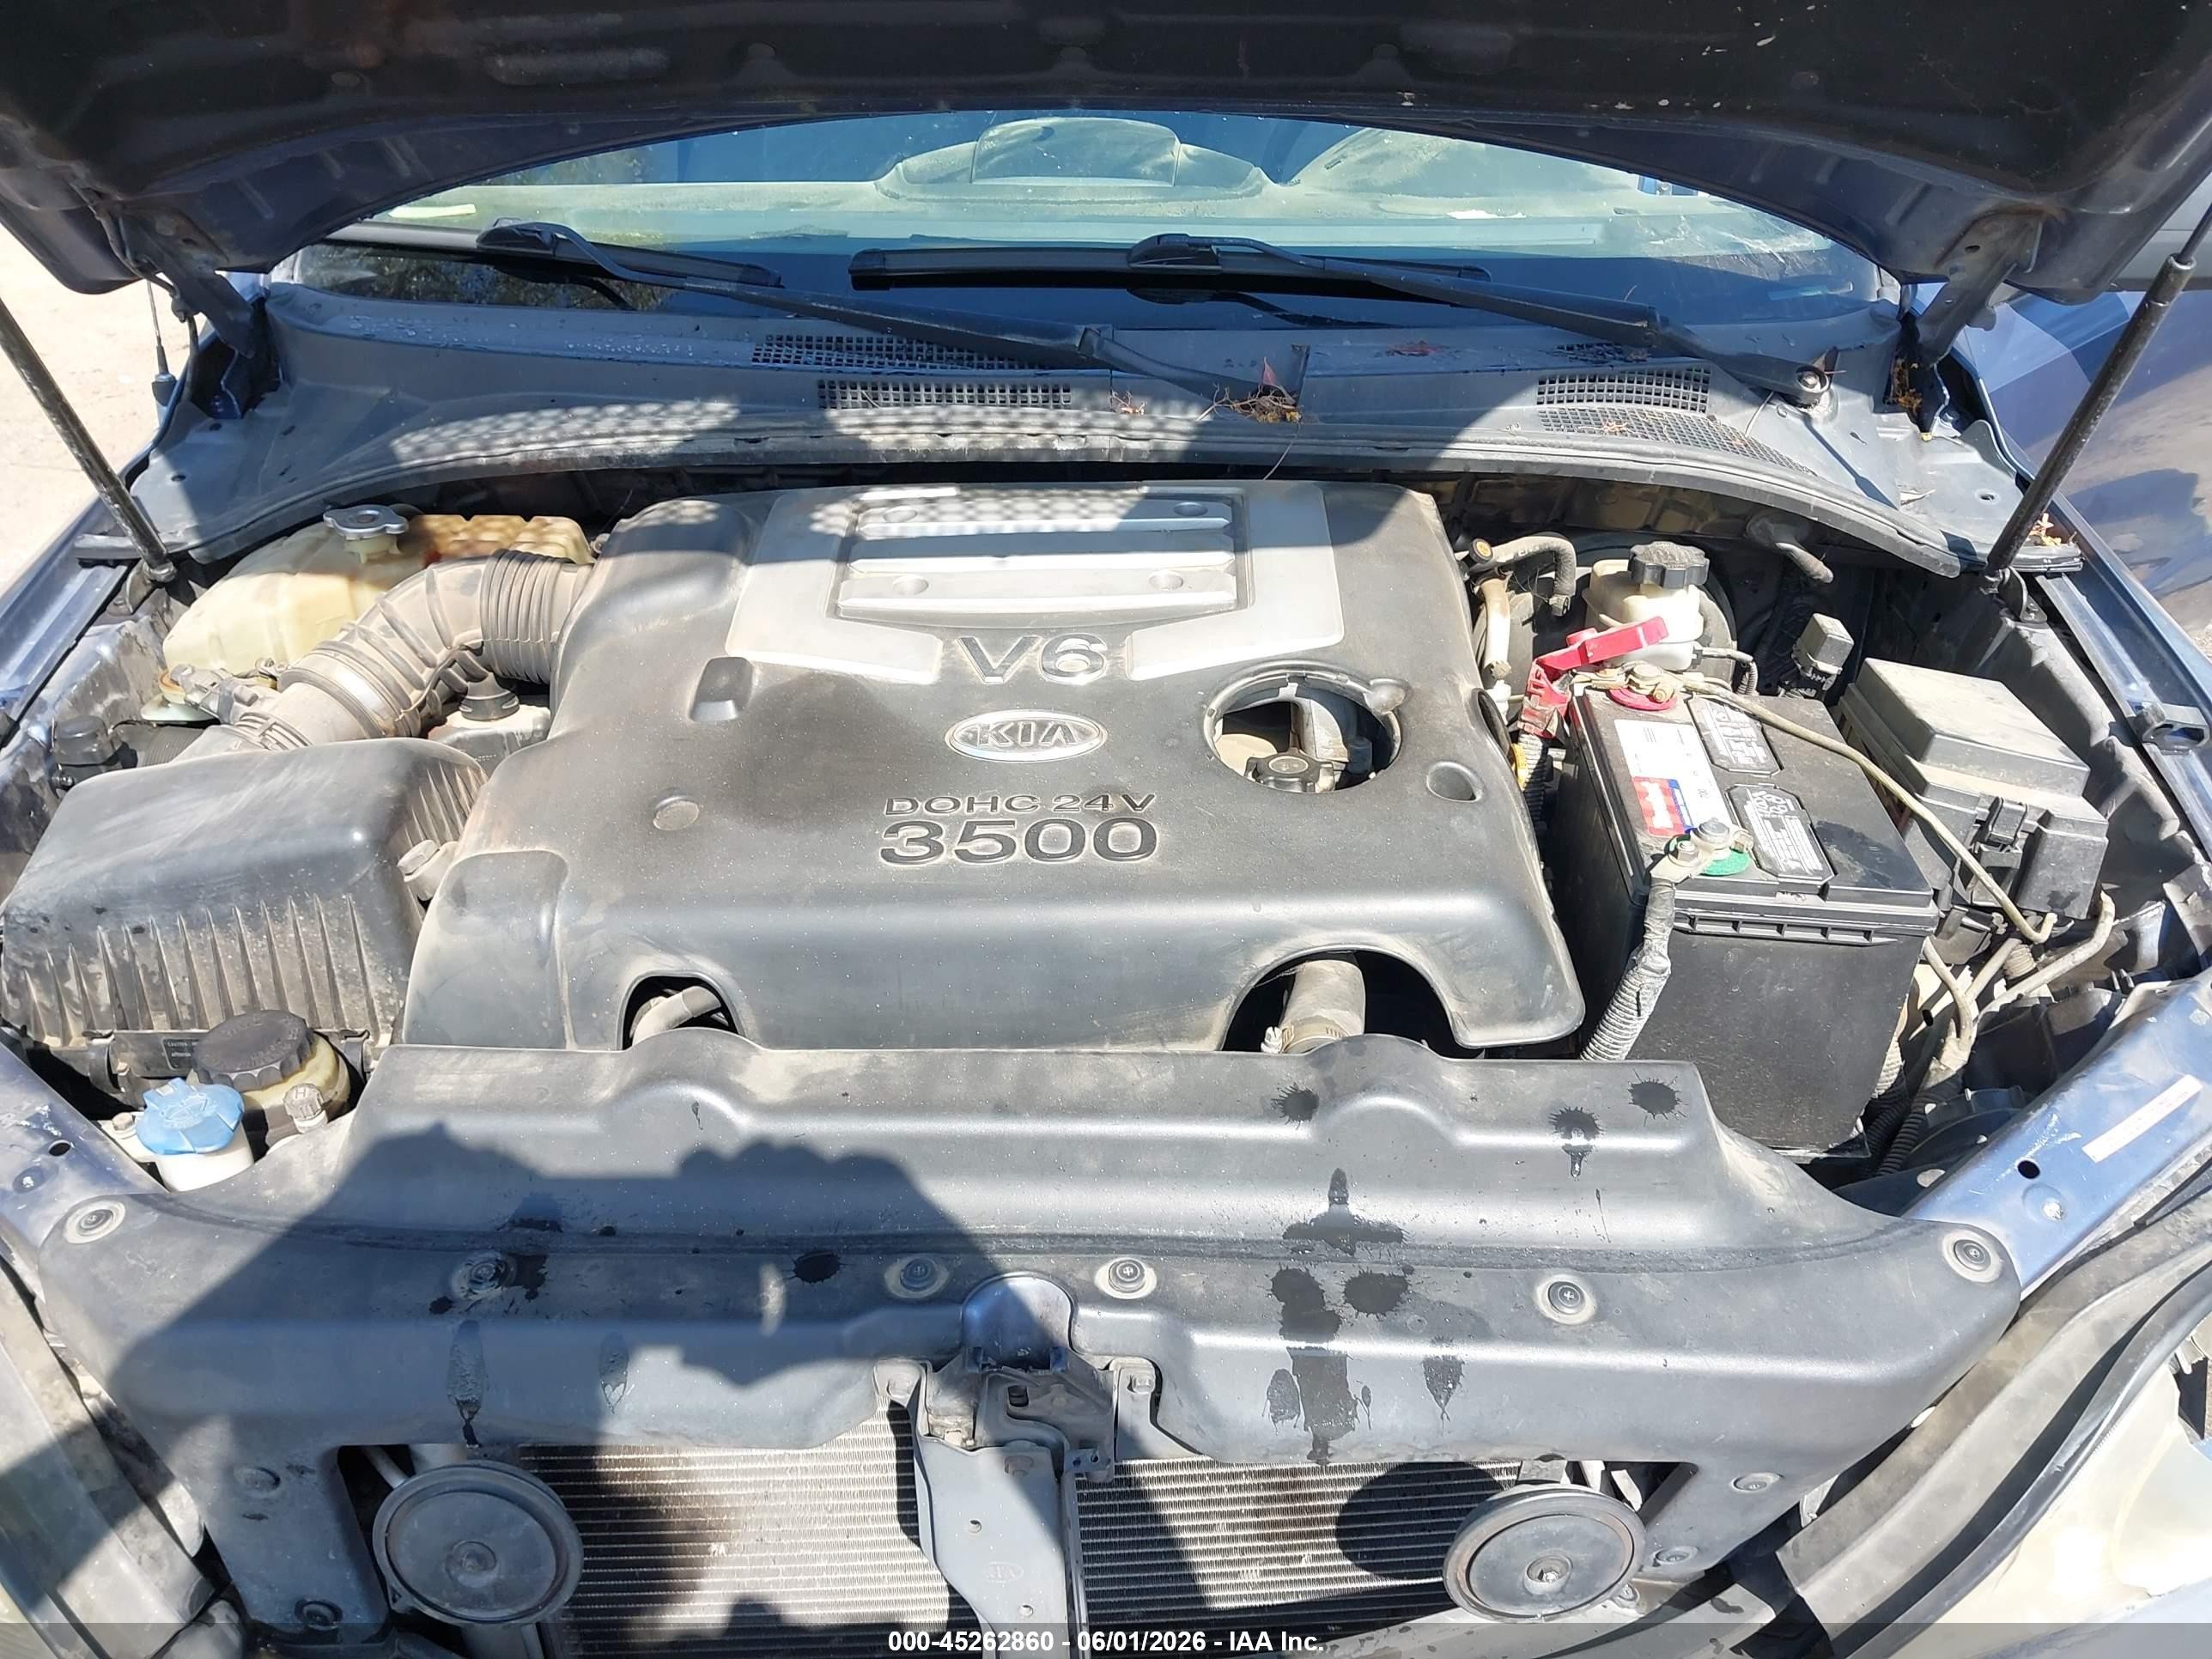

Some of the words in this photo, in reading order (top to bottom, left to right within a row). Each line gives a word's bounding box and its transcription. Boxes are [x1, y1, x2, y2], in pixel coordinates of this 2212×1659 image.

[955, 632, 1108, 684] V6
[976, 720, 1079, 748] KIA
[884, 794, 1040, 816] DOHC
[879, 817, 1158, 865] 3500
